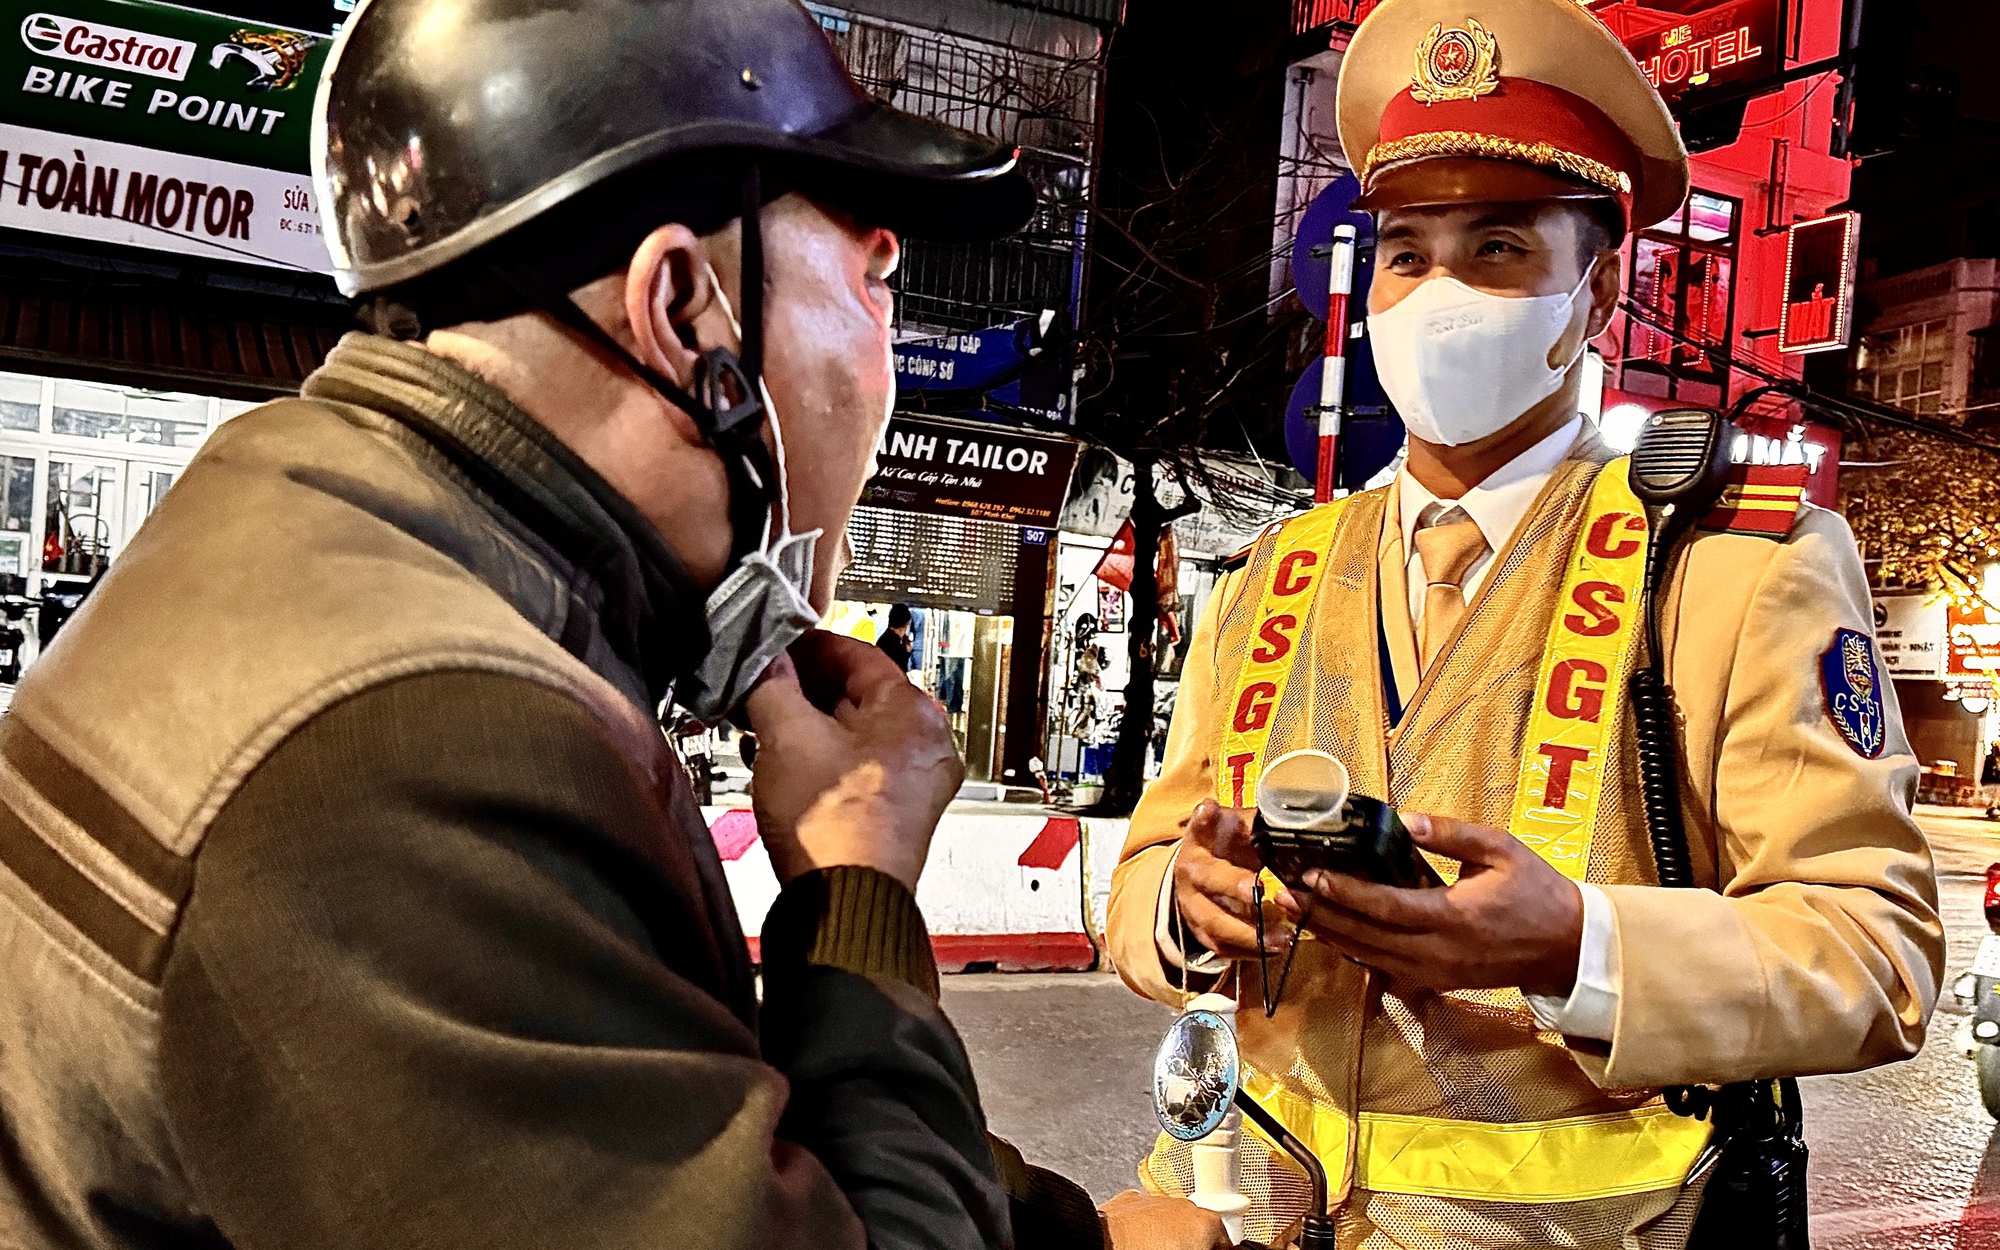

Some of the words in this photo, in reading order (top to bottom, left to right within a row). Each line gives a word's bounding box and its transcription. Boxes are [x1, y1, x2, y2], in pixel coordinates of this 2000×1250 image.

[64, 25, 182, 73] Castrol
[1637, 26, 1762, 89] HOTEL
[22, 66, 132, 108] BIKE
[147, 89, 285, 135] POINT
[17, 149, 119, 218] TOÀN
[122, 171, 254, 241] MOTOR
[946, 438, 1048, 475] TAILOR
[1026, 529, 1045, 543] 507
